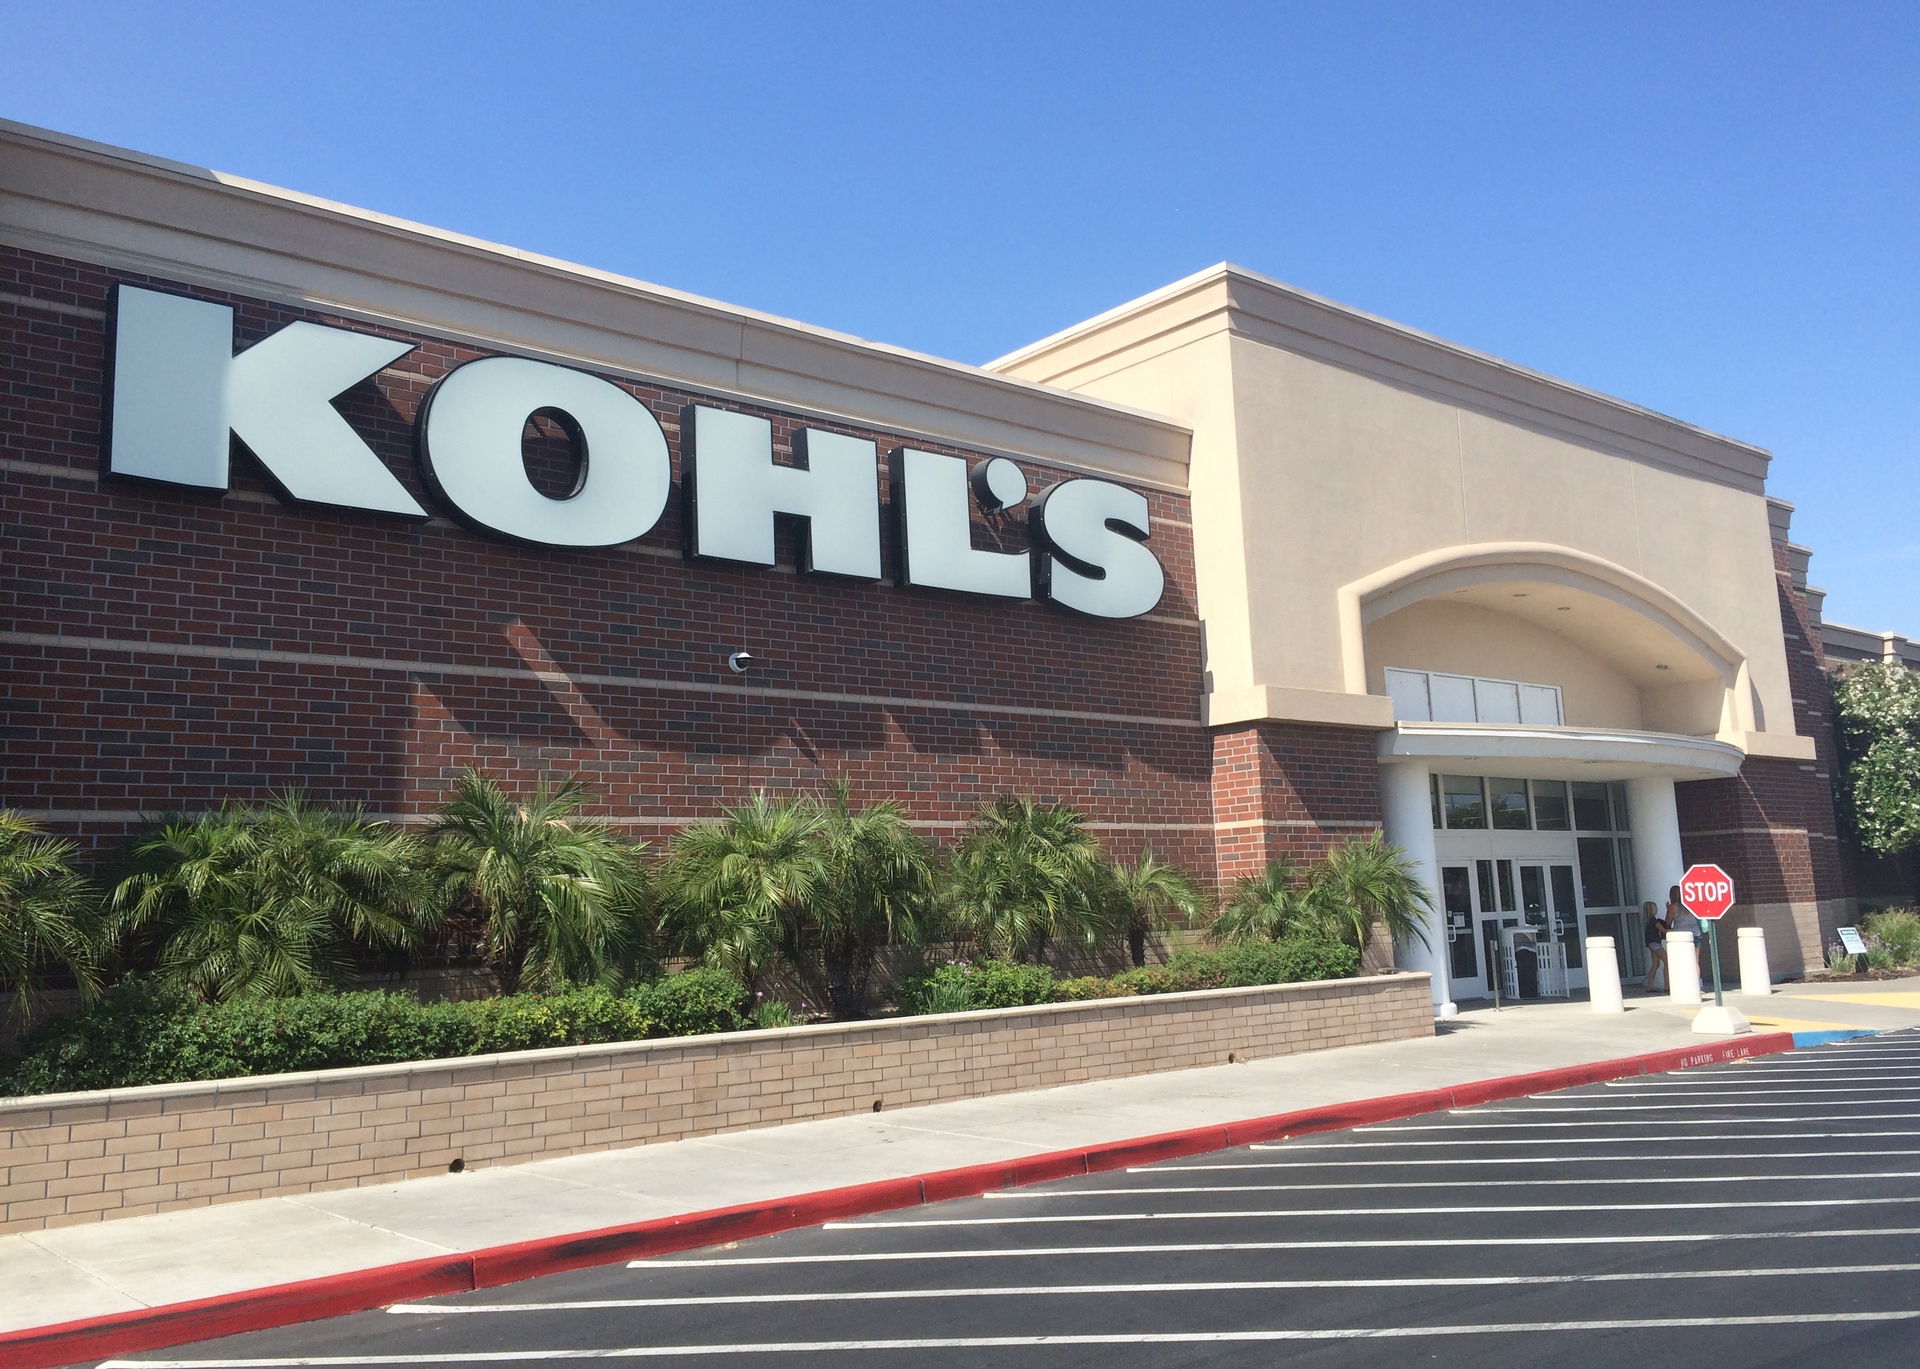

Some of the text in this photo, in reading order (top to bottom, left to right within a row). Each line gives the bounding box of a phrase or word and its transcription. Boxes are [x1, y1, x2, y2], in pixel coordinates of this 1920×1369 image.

[109, 283, 1166, 619] KOHL'S
[1684, 881, 1729, 902] STOP
[1690, 1053, 1713, 1066] PARKING
[1722, 1049, 1735, 1059] FIRE
[1737, 1047, 1750, 1057] LANE
